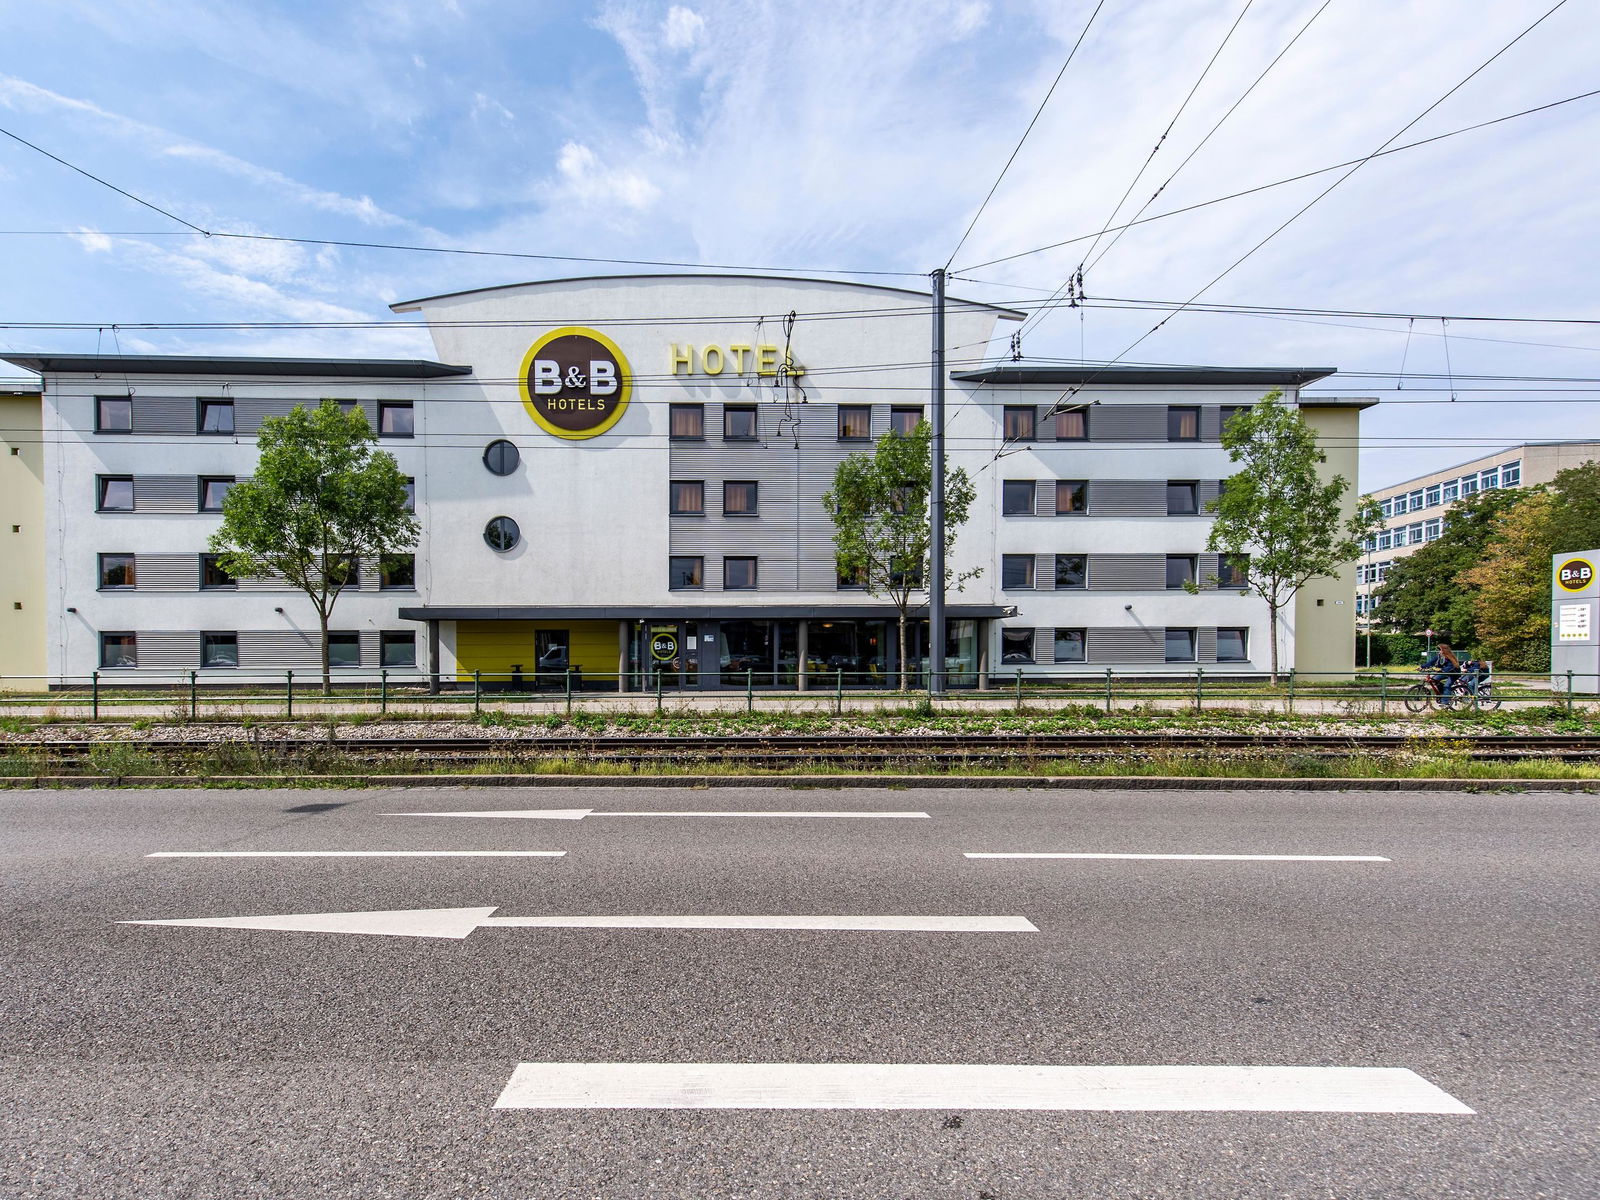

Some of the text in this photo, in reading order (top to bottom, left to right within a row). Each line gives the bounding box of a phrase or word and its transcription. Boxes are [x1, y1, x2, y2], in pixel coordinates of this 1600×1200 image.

[671, 344, 805, 377] HOTEL
[534, 359, 618, 395] B&B
[547, 398, 606, 411] HOTELS
[1562, 568, 1591, 580] B&B
[654, 642, 674, 650] B&B
